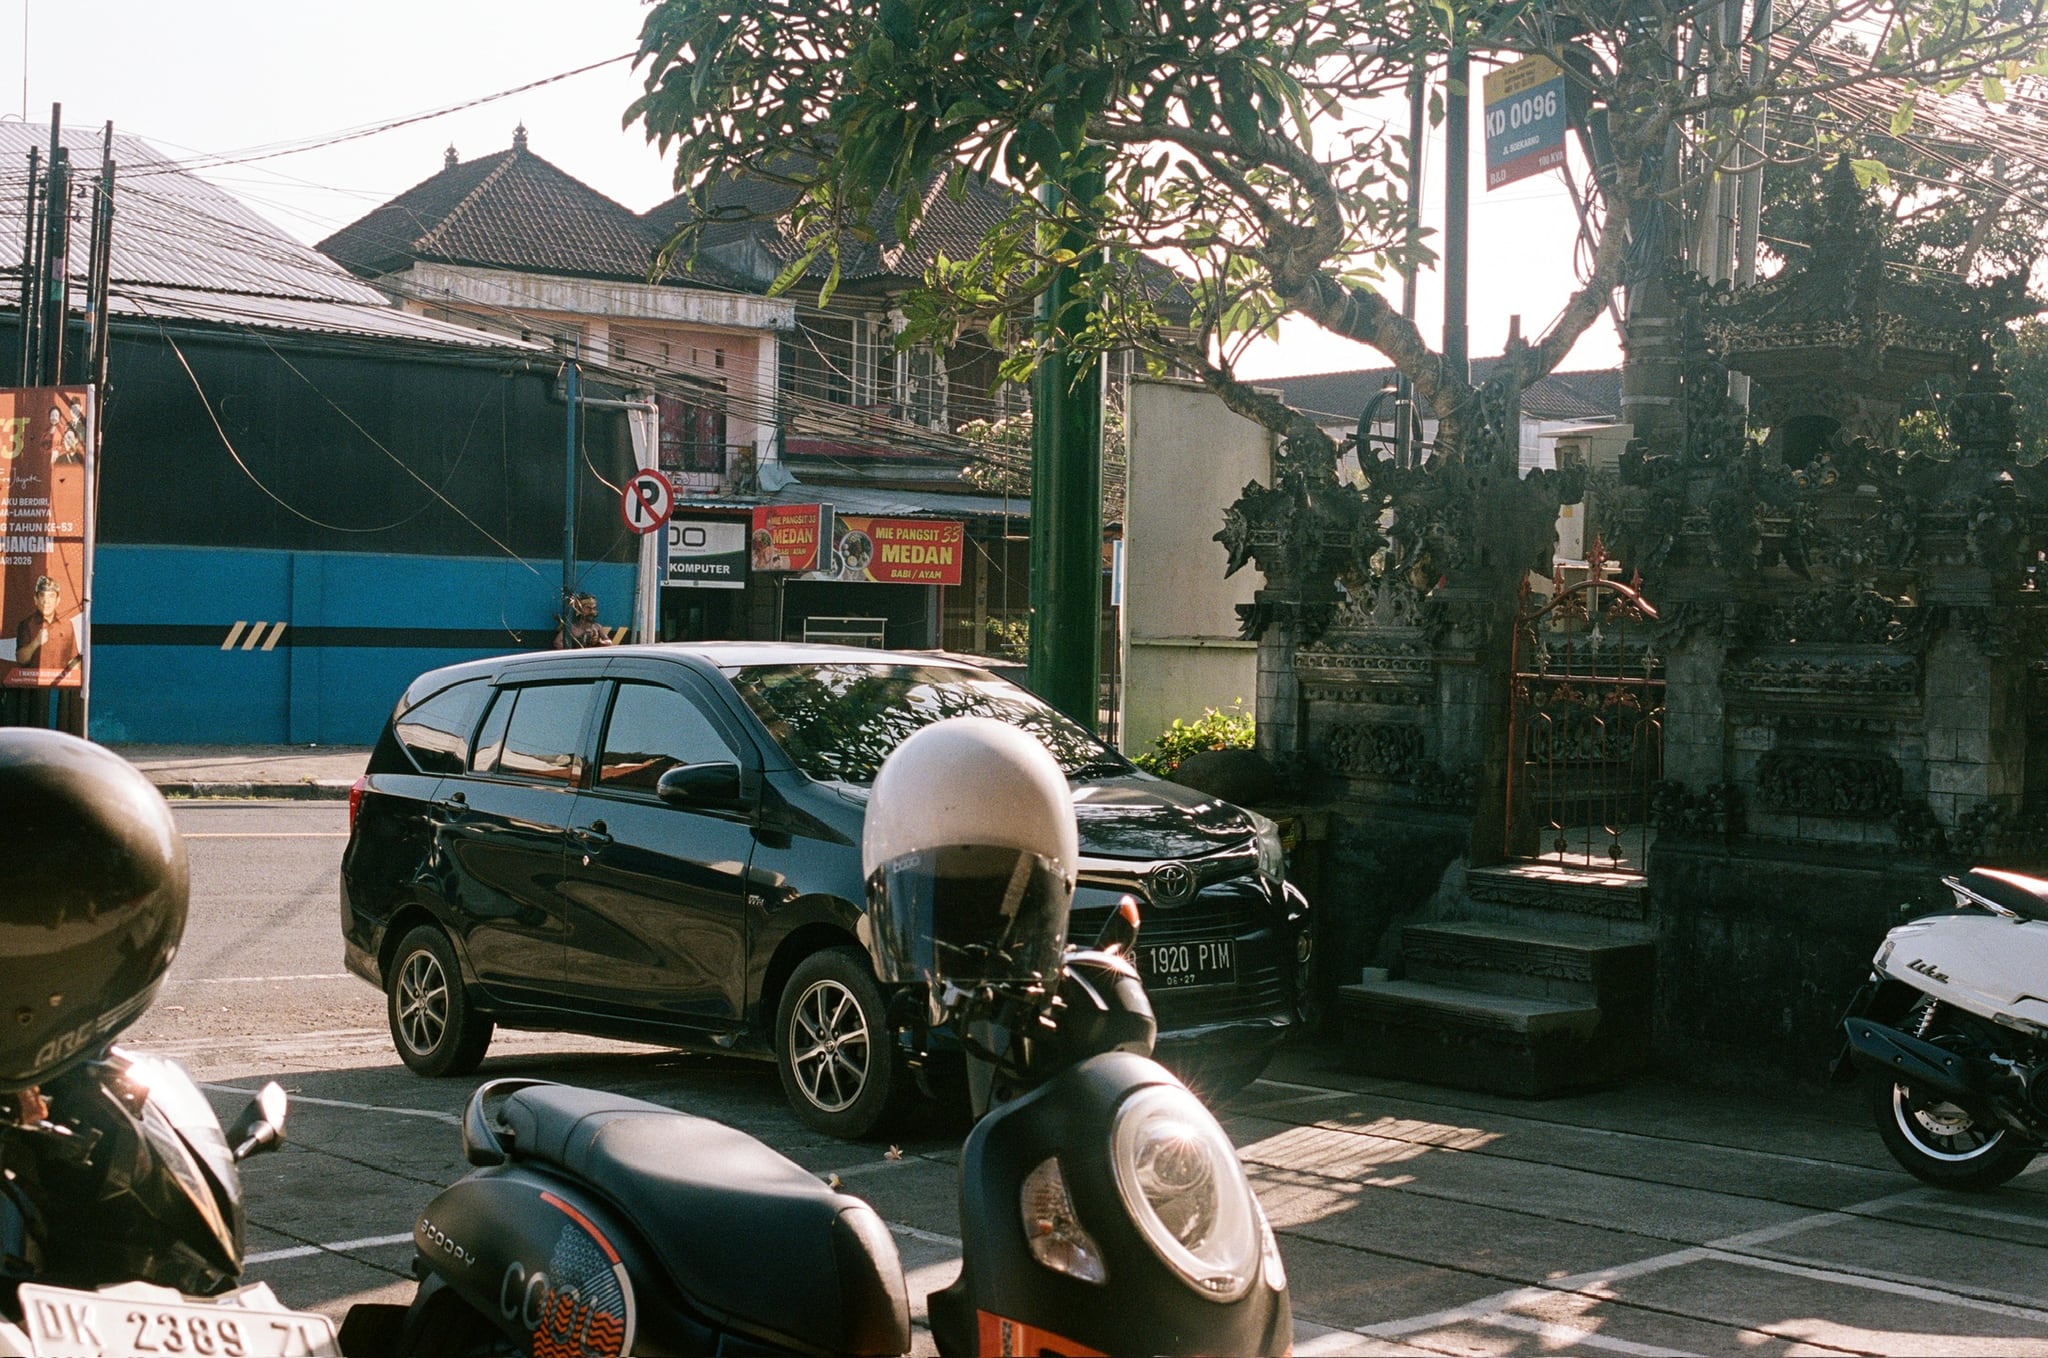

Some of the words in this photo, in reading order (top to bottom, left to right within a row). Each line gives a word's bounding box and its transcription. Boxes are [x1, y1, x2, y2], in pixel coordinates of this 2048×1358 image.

[1486, 109, 1505, 139] KD
[1510, 91, 1557, 129] 0096
[0, 417, 31, 459] 3
[1, 497, 18, 506] AKU
[635, 481, 660, 522] P
[9, 522, 43, 532] TAHUN
[44, 522, 73, 532] KE-53
[773, 528, 813, 544] MEDAN
[875, 527, 894, 539] MIE
[896, 529, 940, 541] PANGSIT
[941, 526, 961, 543] 33
[0, 535, 54, 553] UANGAN
[13, 556, 32, 565] 2026
[881, 544, 953, 565] MEDAN
[669, 563, 731, 575] KOMPUTER
[891, 569, 911, 578] BABI
[918, 571, 942, 579] AYAM
[1150, 946, 1190, 974] 1920
[1199, 942, 1230, 971] PIM
[421, 1219, 476, 1267] SCOOPY
[34, 1299, 102, 1348] DK
[126, 1311, 246, 1357] 2389
